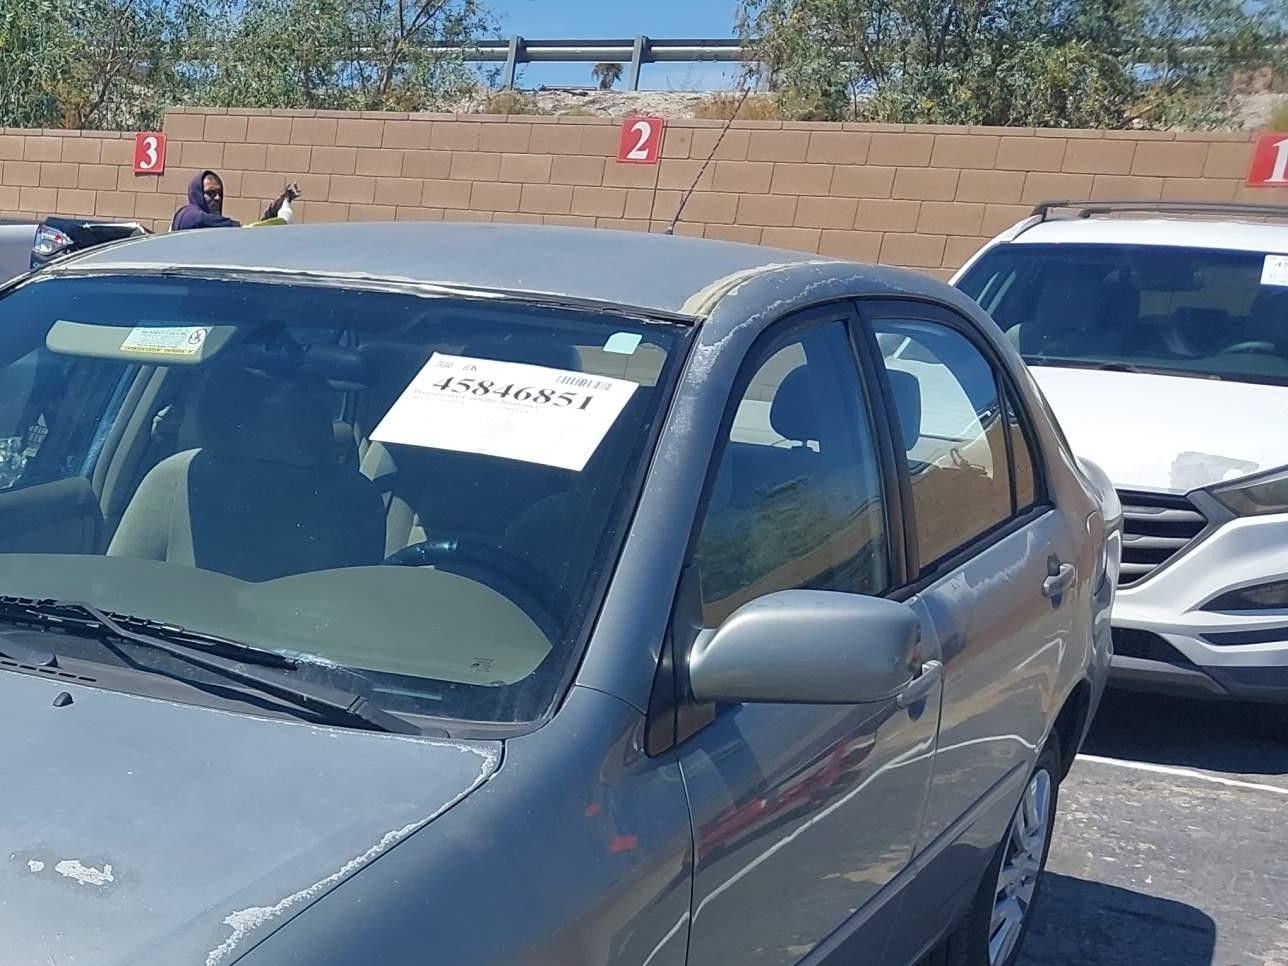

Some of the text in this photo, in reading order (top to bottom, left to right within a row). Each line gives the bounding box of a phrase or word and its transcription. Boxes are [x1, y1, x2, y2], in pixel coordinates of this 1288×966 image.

[139, 136, 158, 169] 3
[625, 120, 652, 160] 2
[1263, 138, 1288, 183] 1
[432, 375, 595, 411] 45846851
